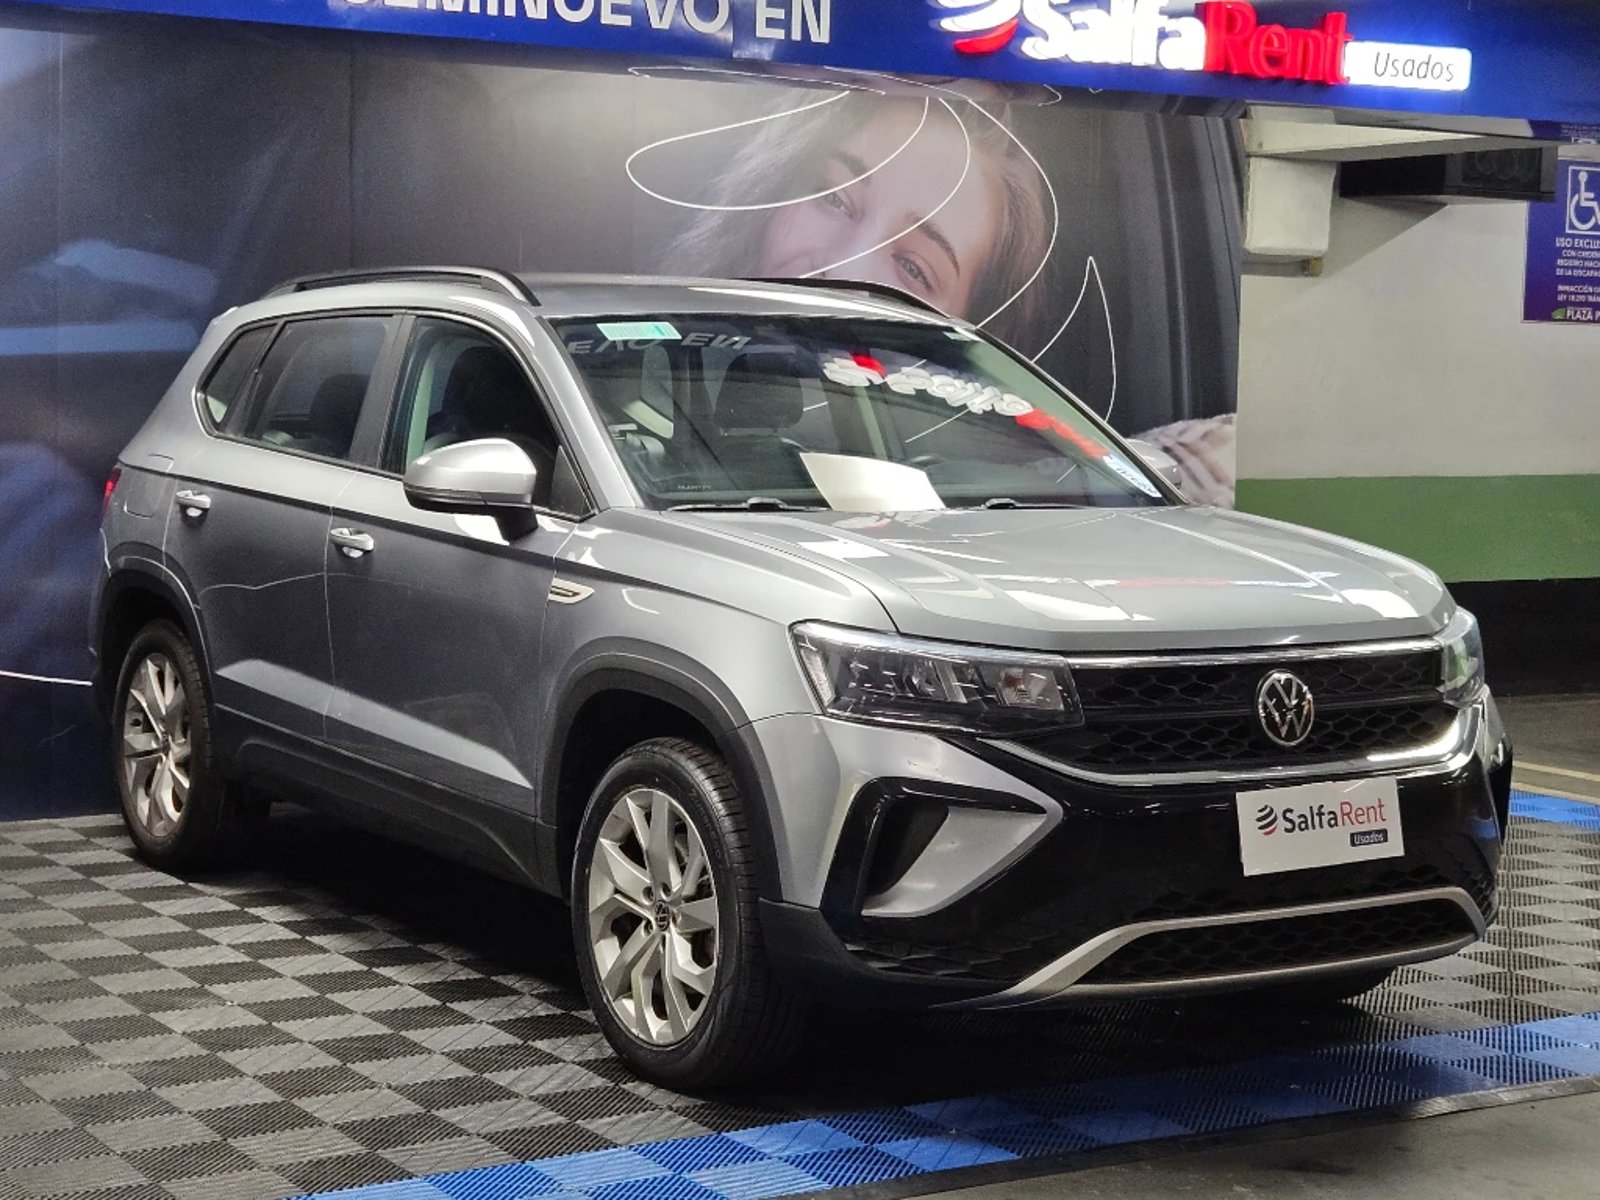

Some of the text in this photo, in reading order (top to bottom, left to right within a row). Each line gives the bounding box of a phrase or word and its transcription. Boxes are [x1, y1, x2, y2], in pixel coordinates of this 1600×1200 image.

[755, 0, 831, 44] EN
[1021, 0, 1454, 86] SalfaRent Usados
[1566, 307, 1593, 321] PLAZA
[1281, 797, 1387, 846] SalfaRent Usados
